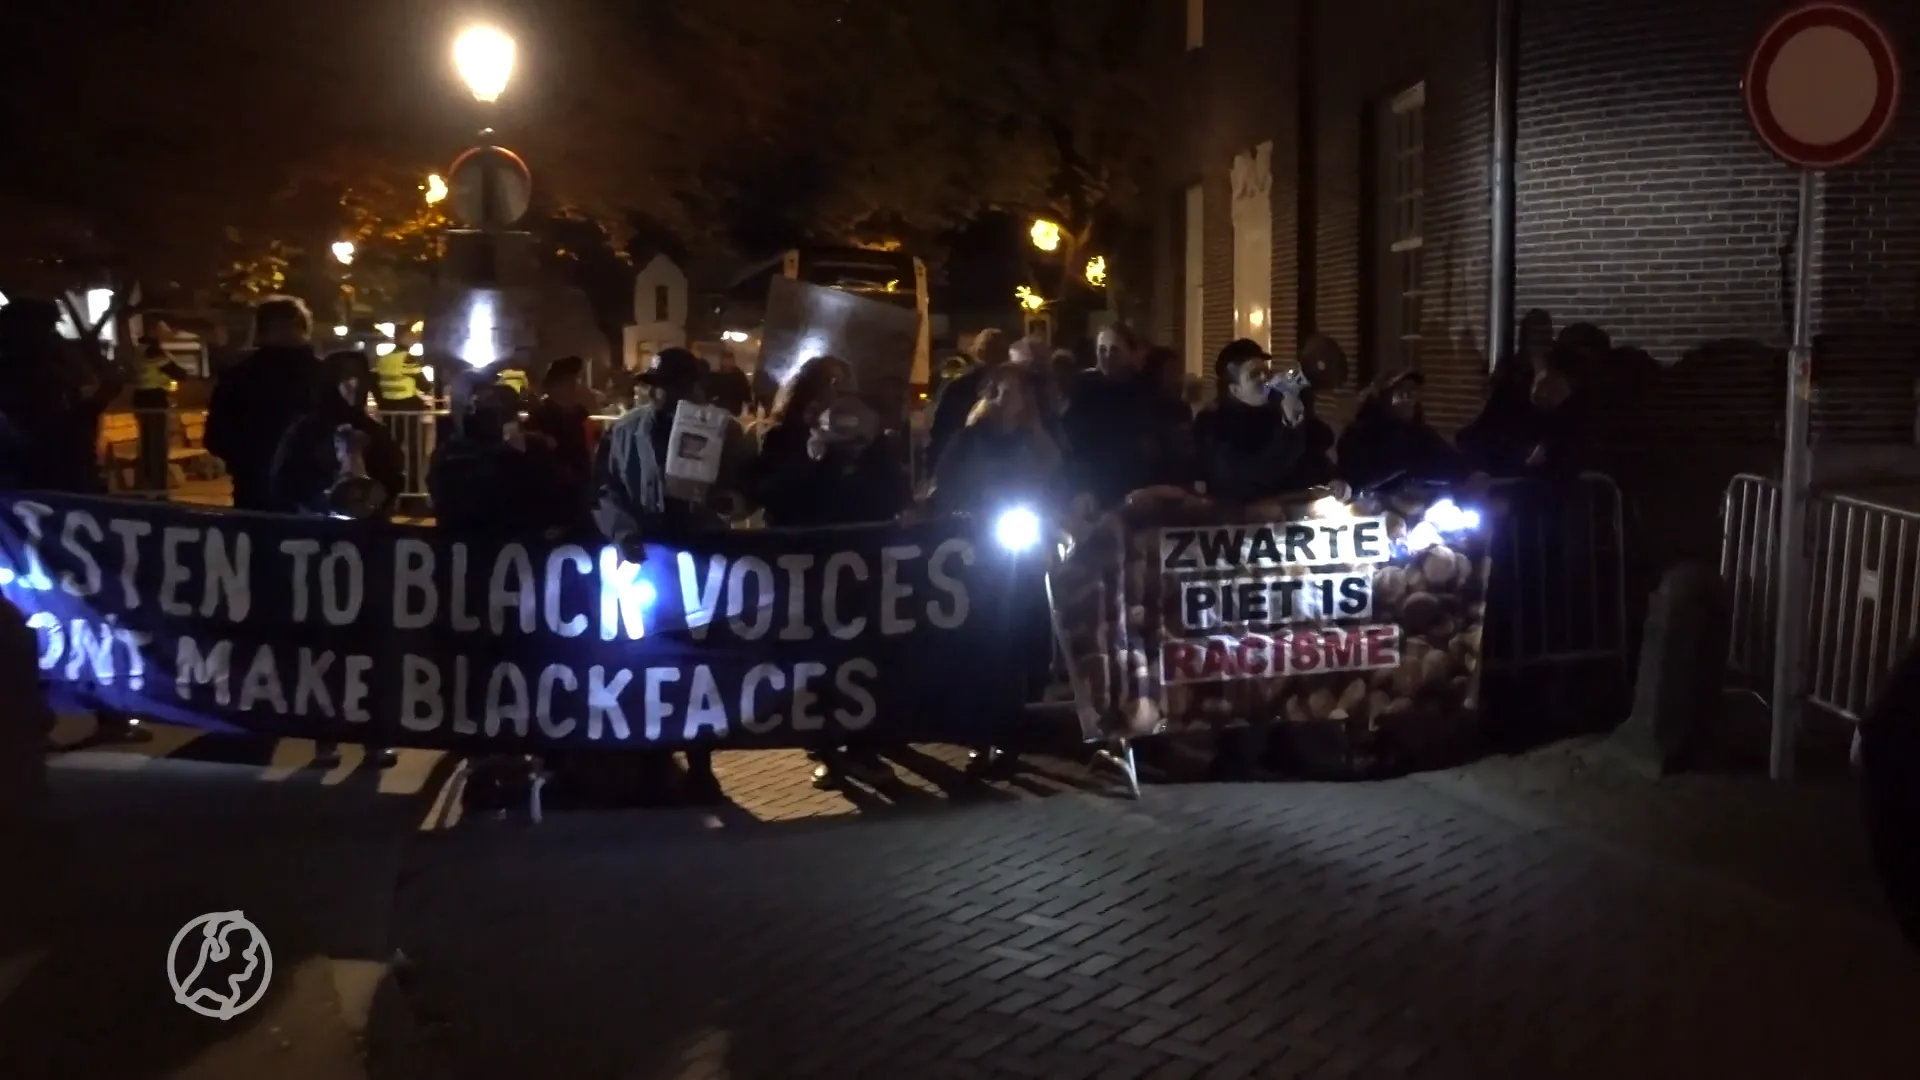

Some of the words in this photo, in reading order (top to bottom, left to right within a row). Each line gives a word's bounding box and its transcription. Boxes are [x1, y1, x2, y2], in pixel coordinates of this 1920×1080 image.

[1165, 521, 1380, 568] ZWARTE
[0, 501, 251, 622] ISTEN
[280, 539, 364, 626] TO
[393, 538, 646, 643] BLACK
[677, 538, 975, 641] VOICES
[1186, 580, 1302, 625] PIET
[1321, 577, 1367, 615] IS
[26, 611, 152, 691] ON'T
[175, 635, 373, 723] MAKE
[401, 653, 878, 742] BLACKFACES
[1165, 628, 1395, 681] RACISME
